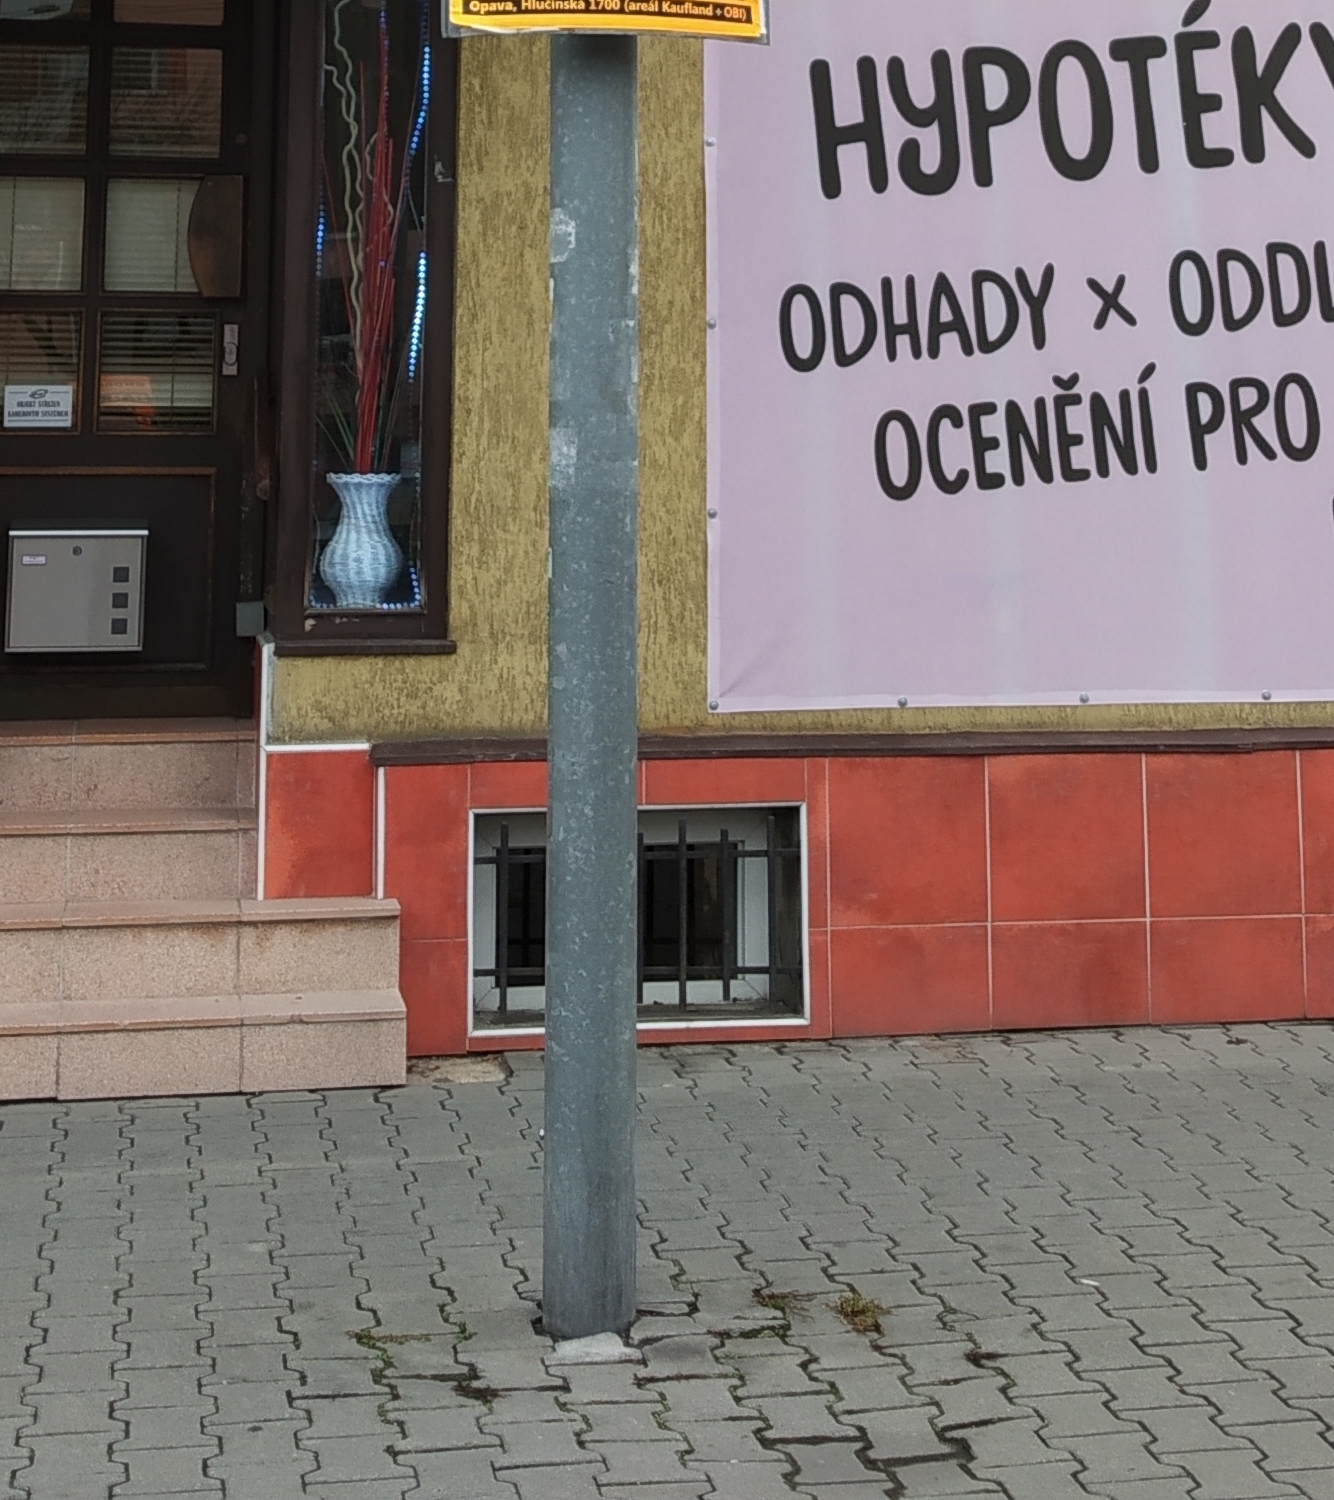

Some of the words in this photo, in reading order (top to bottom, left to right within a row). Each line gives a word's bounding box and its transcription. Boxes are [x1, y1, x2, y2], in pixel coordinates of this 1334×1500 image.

[469, 1, 517, 14] Opava,
[624, 0, 660, 13] (areál
[662, 1, 714, 17] Kaufland
[779, 262, 1055, 373] ODHADY
[874, 362, 1157, 501] OCENĚNÍ
[1184, 372, 1320, 472] PRO
